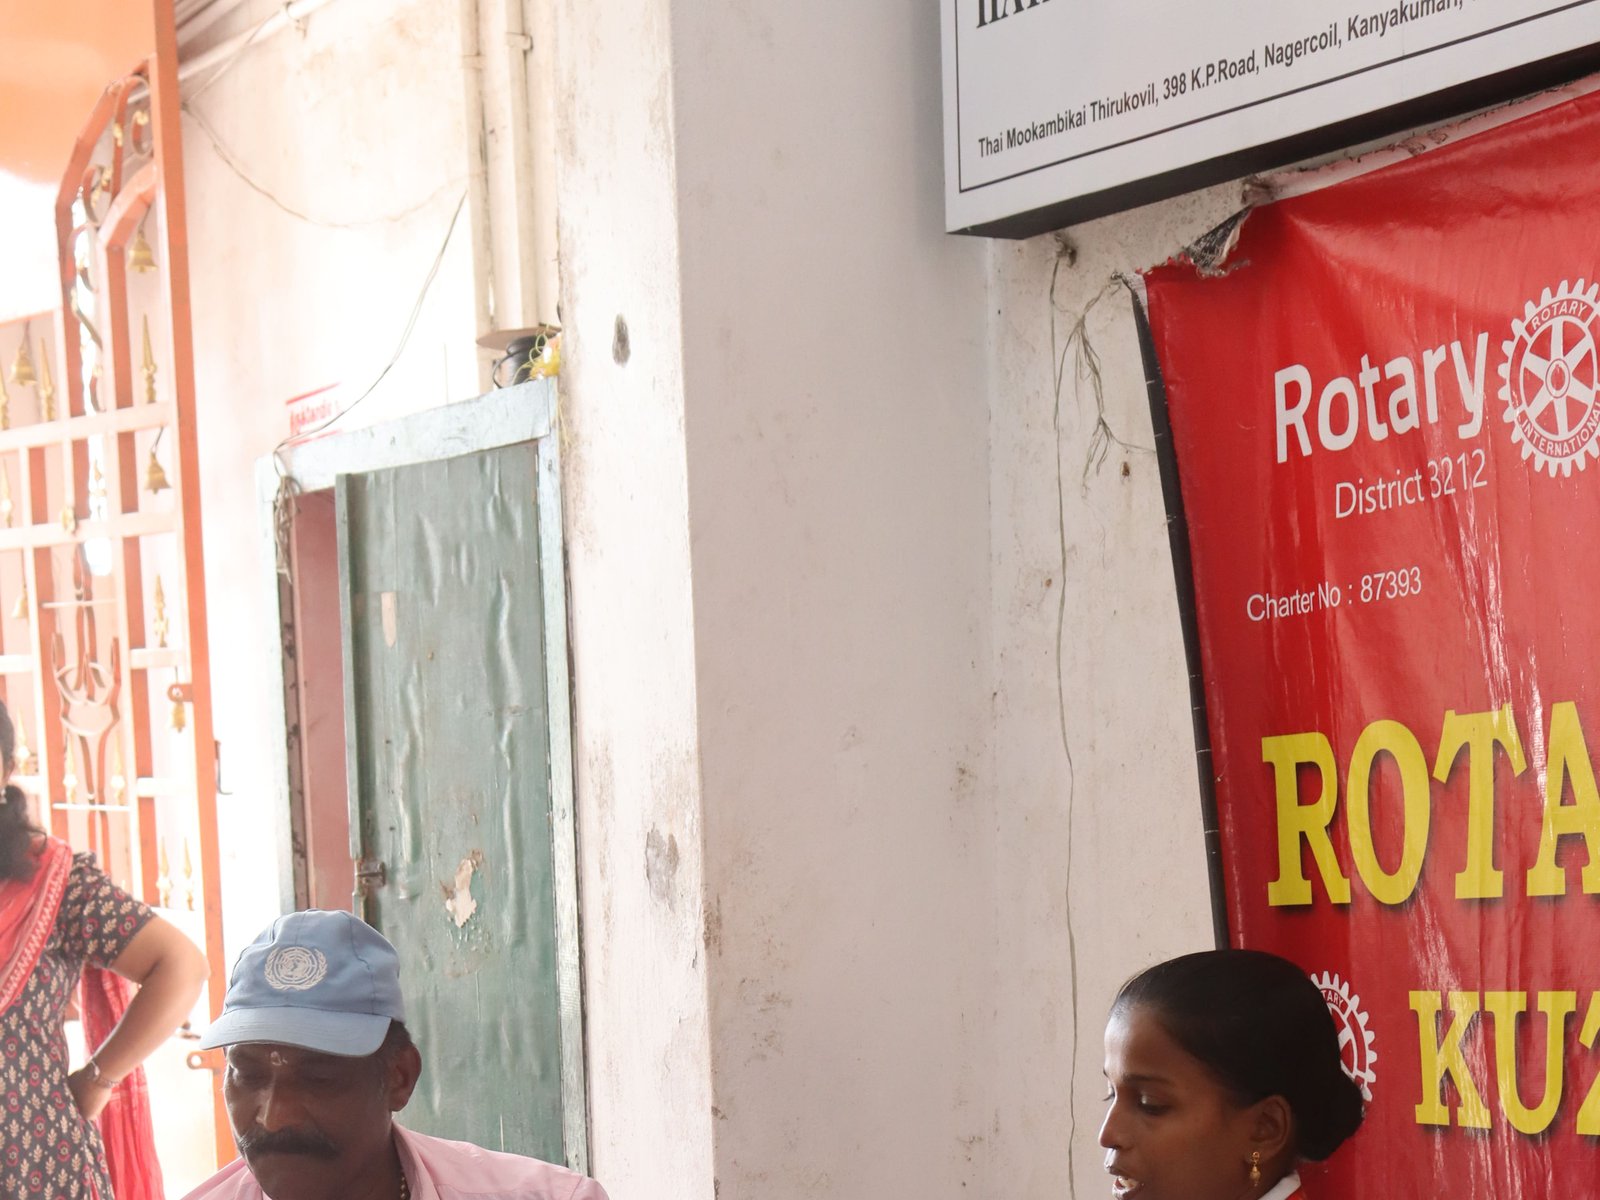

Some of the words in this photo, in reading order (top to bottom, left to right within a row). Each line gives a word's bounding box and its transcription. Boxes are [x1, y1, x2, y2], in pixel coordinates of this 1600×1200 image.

[979, 131, 1003, 158] Thai
[1006, 105, 1087, 148] Mookambikai
[1090, 83, 1160, 122] Thirukovil,
[1163, 72, 1188, 100] 398
[1191, 49, 1260, 91] K.P.Road,
[1264, 23, 1343, 68] Nagercoil,
[1530, 299, 1588, 332] ROTARY
[1274, 331, 1489, 464] Rotary
[1335, 469, 1425, 519] District
[1427, 448, 1488, 499] 3212
[1246, 589, 1315, 622] Charter
[1318, 580, 1342, 610] No
[1360, 566, 1423, 603] 87393
